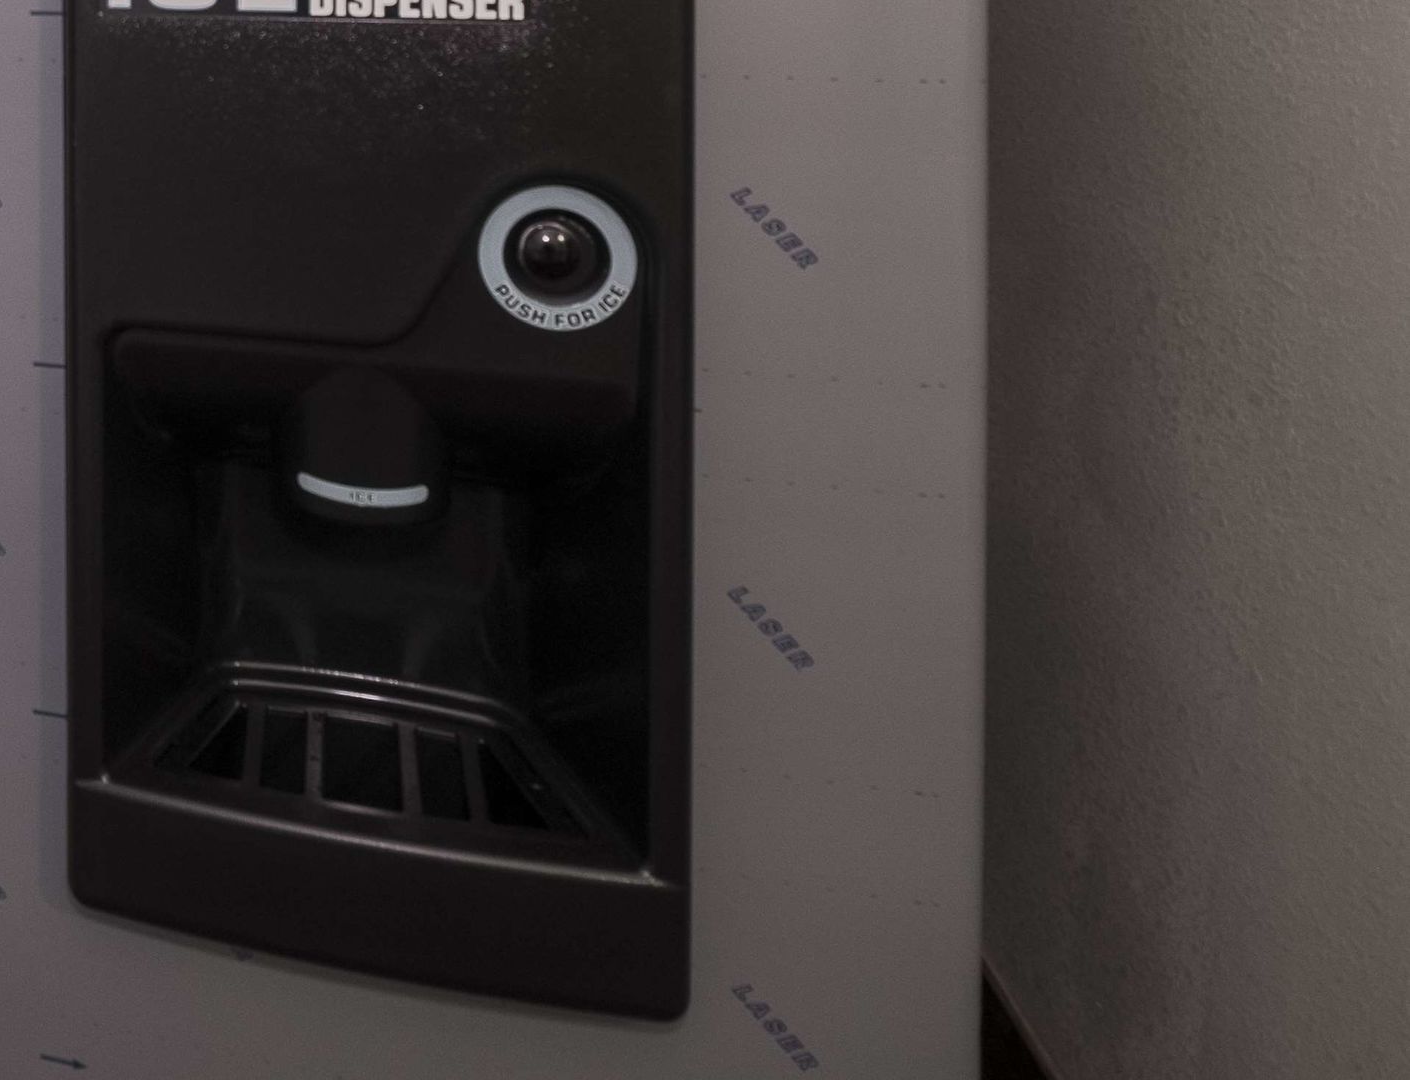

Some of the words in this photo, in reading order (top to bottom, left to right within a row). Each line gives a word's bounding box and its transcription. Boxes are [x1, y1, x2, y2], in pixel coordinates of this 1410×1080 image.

[730, 187, 819, 270] LASER
[495, 284, 547, 324] PUSH
[555, 309, 596, 328] FOR
[598, 284, 627, 312] ICE
[728, 586, 815, 671] LASER
[732, 984, 819, 1071] LASER
